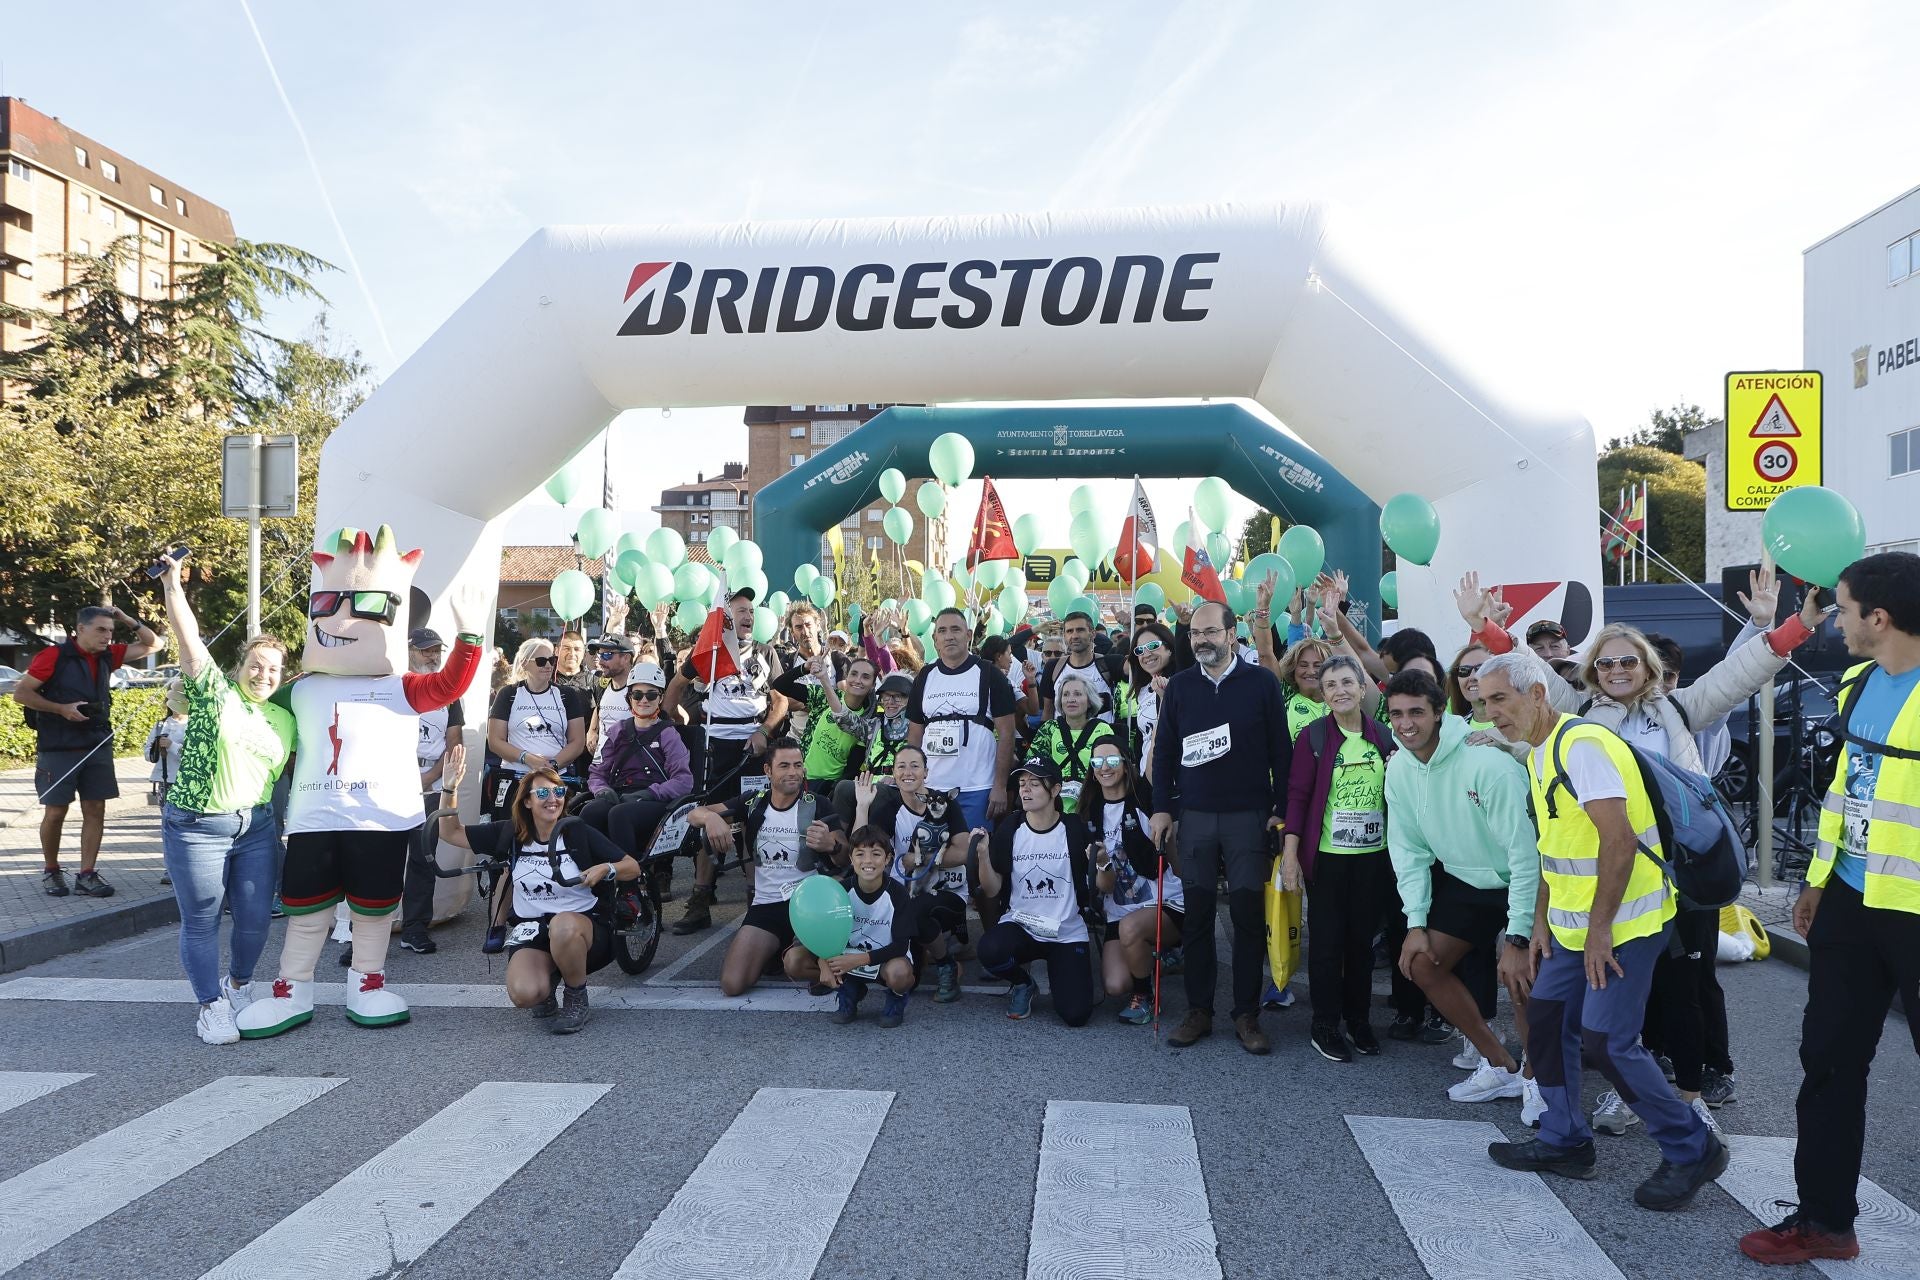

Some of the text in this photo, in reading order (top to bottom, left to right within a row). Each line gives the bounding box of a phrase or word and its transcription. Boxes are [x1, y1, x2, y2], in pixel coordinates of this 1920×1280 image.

[616, 252, 1220, 336] BRIDGESTONE
[1878, 338, 1920, 375] PABEL
[1736, 375, 1814, 390] ATENCIÓN
[997, 429, 1124, 438] AYUNTAMIENTO TORRELAVEGA
[1763, 454, 1788, 469] 30
[942, 737, 953, 746] 69
[1209, 736, 1227, 750] 393
[299, 781, 321, 791] Sentir
[324, 779, 332, 789] el
[1364, 822, 1380, 834] 197
[944, 872, 963, 882] 334
